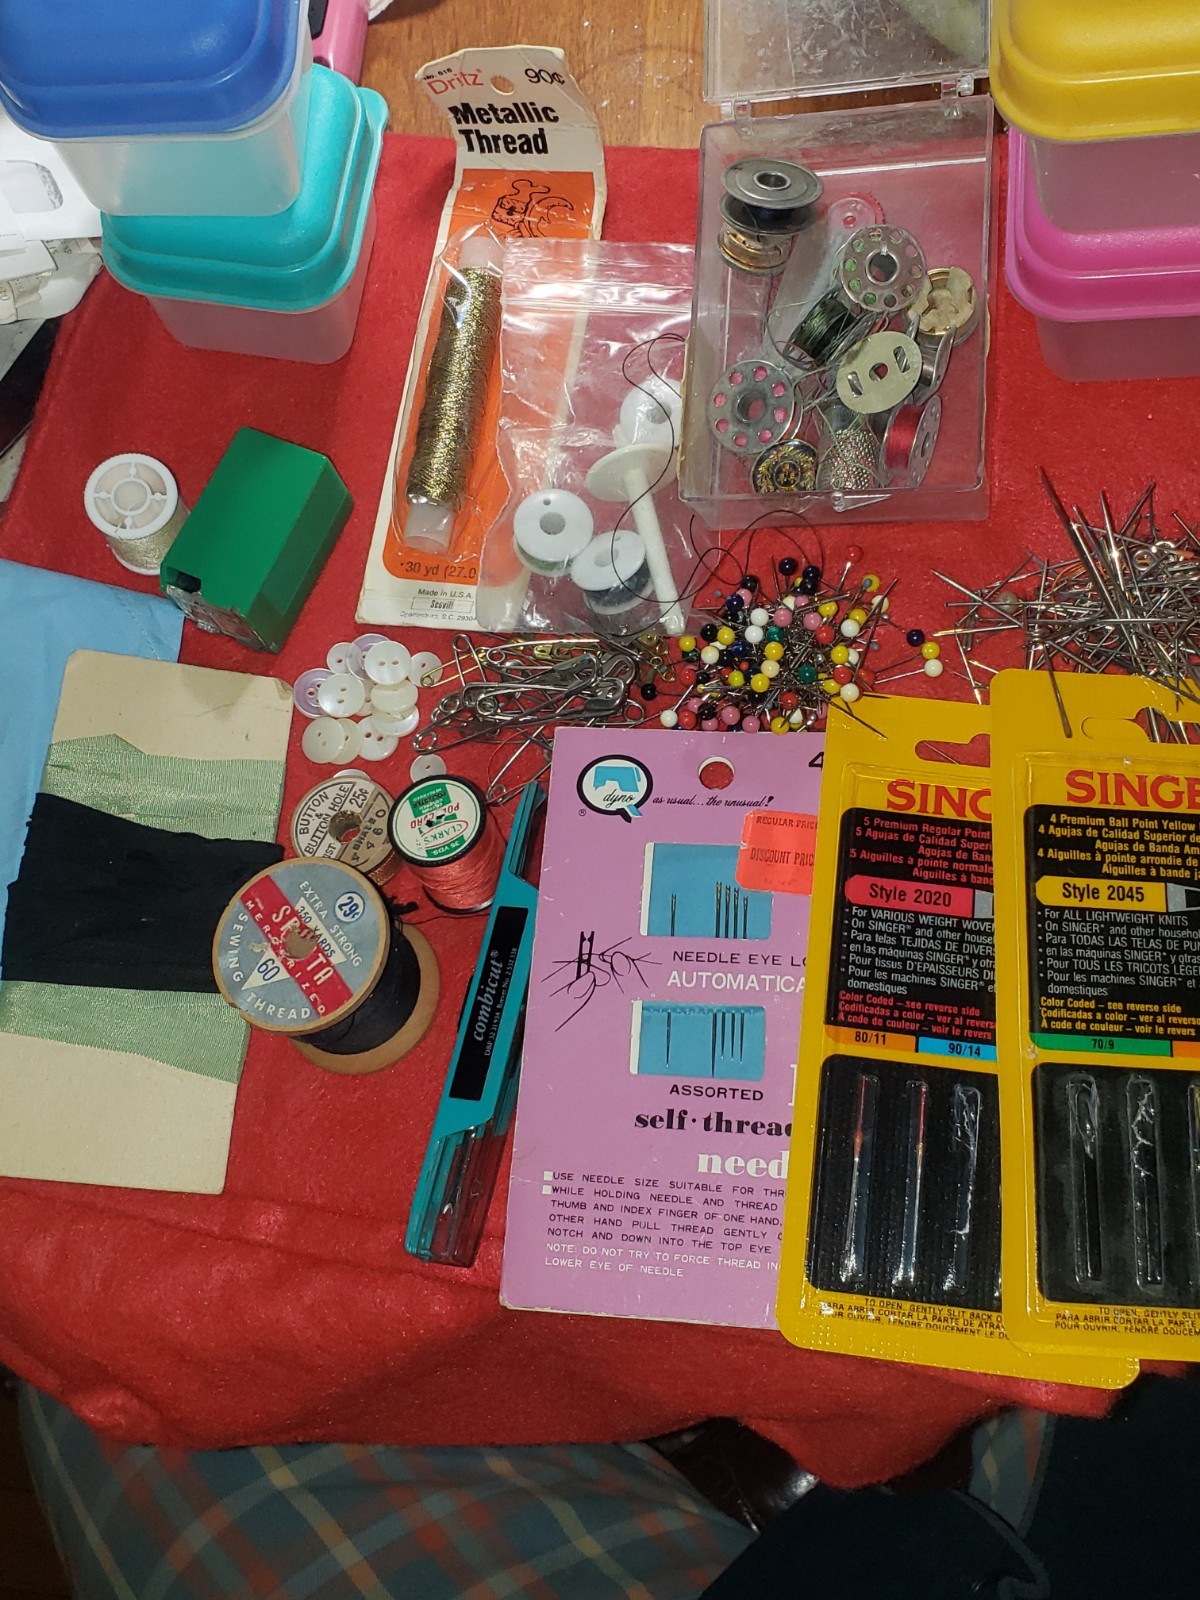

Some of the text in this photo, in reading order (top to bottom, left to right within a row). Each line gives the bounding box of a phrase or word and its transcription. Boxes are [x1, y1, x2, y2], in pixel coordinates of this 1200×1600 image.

[427, 71, 484, 95] Dritz
[448, 102, 559, 124] Metallic
[459, 128, 549, 154] Thread
[424, 565, 439, 576] yd
[603, 789, 635, 808] dyno
[652, 796, 663, 804] as
[706, 795, 722, 806] the
[299, 791, 330, 835] BUTTON
[304, 785, 350, 855] BUTTON HOLE
[756, 816, 793, 827] REGULAR
[1050, 814, 1195, 831] 4 Premium Ball Point Yellow
[423, 823, 463, 846] CLARK'S
[856, 827, 956, 847] 5 Agujas de Calidad
[864, 817, 990, 839] 5 Premium Regular Point
[1039, 825, 1185, 843] 4 Agujas de Calidad Superior
[750, 847, 791, 864] DISCOUNT
[869, 883, 952, 907] Style 2020
[1062, 882, 1144, 902] Style 2045
[296, 906, 312, 923] 350
[299, 880, 362, 967] EXTRA STRONG
[852, 906, 867, 917] For
[871, 909, 914, 924] VARIOUS
[919, 914, 958, 928] WEIGHT
[1045, 909, 1188, 926] For ALL LIGHTWEIGHT KNITS
[228, 912, 248, 982] SEWING
[271, 905, 334, 985] SPTA
[1046, 934, 1180, 950] Para TODAS LAS TELAS DE
[673, 950, 741, 964] NEEDLE
[749, 953, 782, 966] EYE
[850, 954, 871, 965] Pour
[875, 956, 902, 970] tissus
[1047, 959, 1169, 975] Pour TOUS LES TRICOTS
[257, 958, 280, 981] 60
[848, 979, 907, 995] domestiques
[1048, 983, 1108, 997] domestiques
[246, 992, 310, 1019] THREAD
[1041, 996, 1181, 1013] Color Coded see reverse side
[855, 1031, 981, 1057] 80/11 90/14
[1092, 1039, 1115, 1049] 70/9
[669, 1084, 764, 1101] ASSORTED
[553, 1172, 787, 1198] USE NEEDLE SIZE SUITABLE FOR THR
[552, 1186, 777, 1211] WHILE HOLDING NEEDLE AND THREAD
[551, 1200, 587, 1210] THUMB
[593, 1203, 614, 1212] AND
[621, 1205, 652, 1215] INDEX
[658, 1209, 698, 1219] FINGER
[704, 1212, 718, 1220] OF
[724, 1214, 745, 1223] ONE
[549, 1214, 767, 1239] OTHER HAND PULL THREAD GENTLY
[548, 1228, 771, 1253] NOTCH AND DOWN INTO THE TOP EYE
[545, 1257, 683, 1277] LOWER EYE OF NEEDLE
[547, 1243, 781, 1271] NOTE: DO NOT TRY TO FORCE THREAD IN
[910, 1305, 944, 1316] GENTLY
